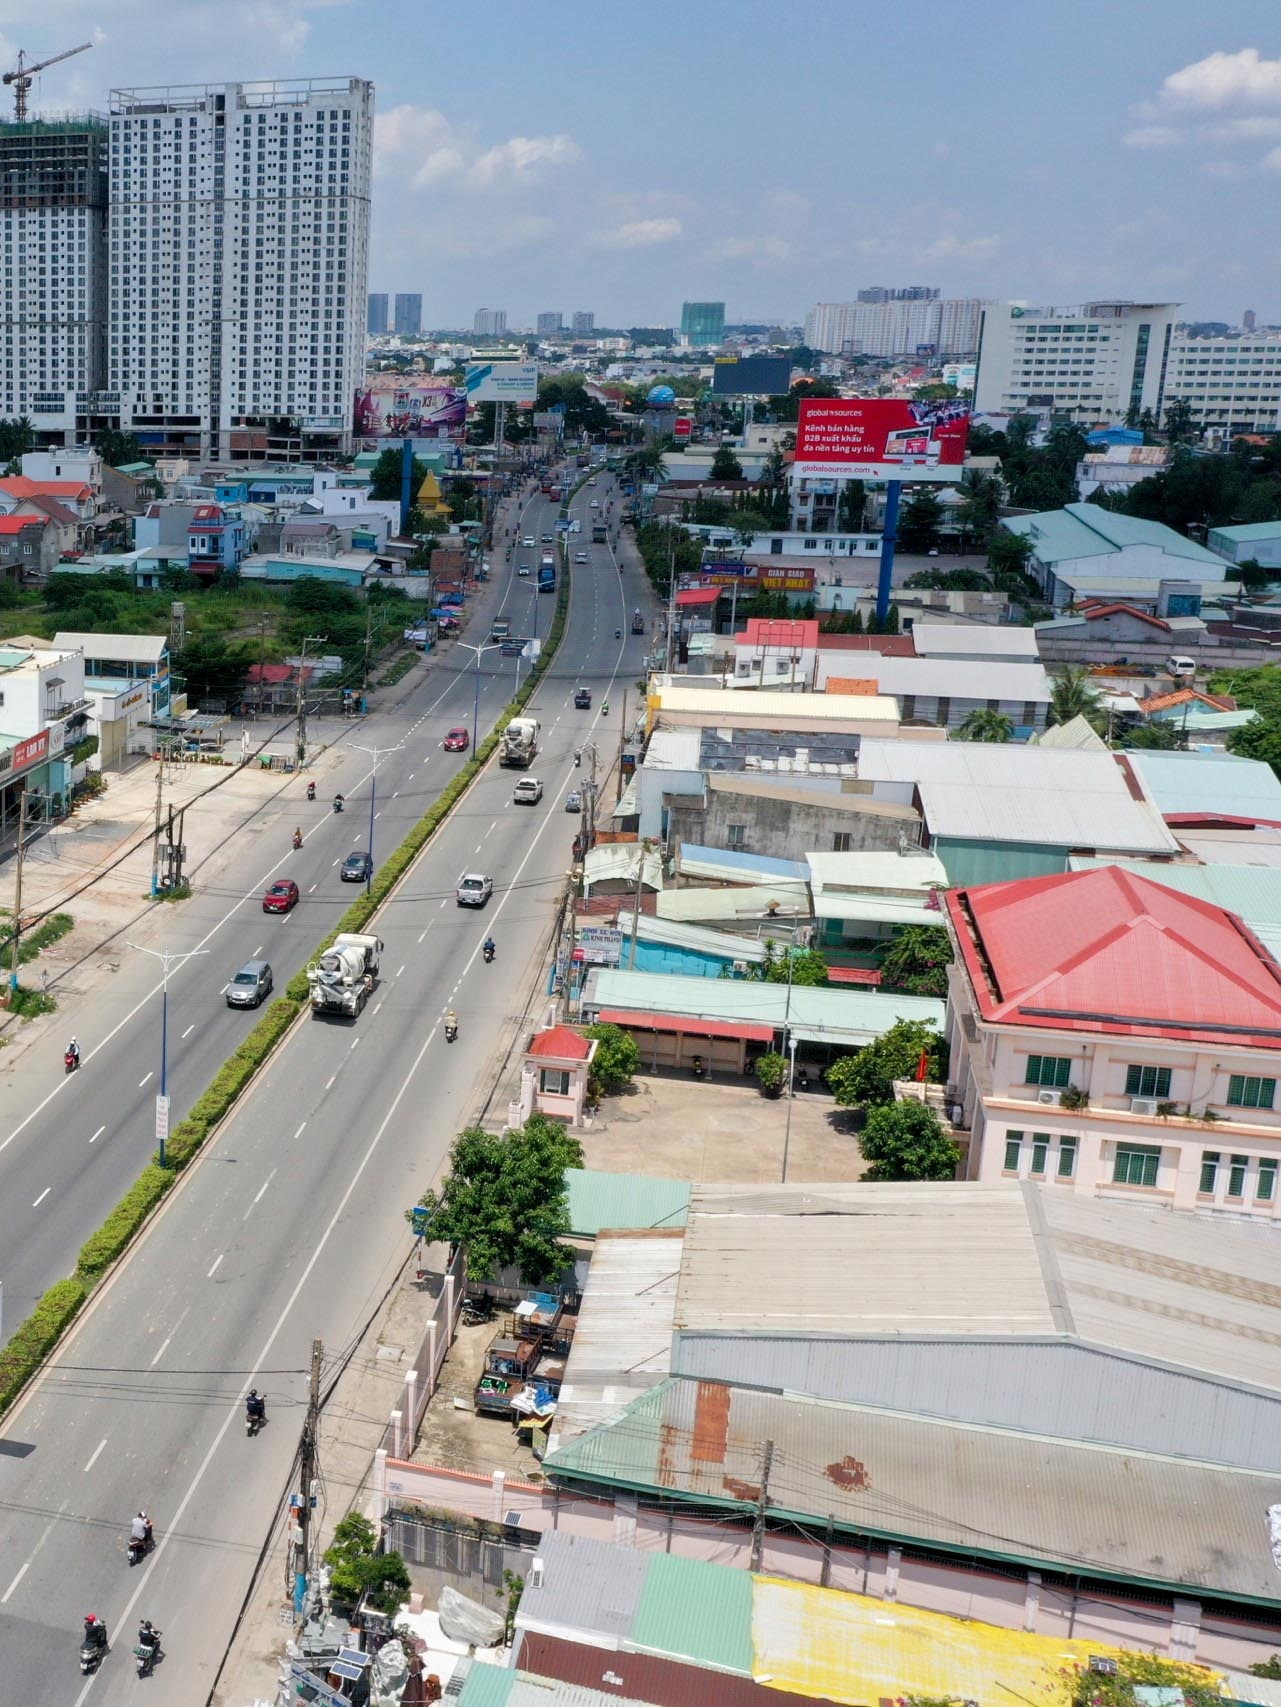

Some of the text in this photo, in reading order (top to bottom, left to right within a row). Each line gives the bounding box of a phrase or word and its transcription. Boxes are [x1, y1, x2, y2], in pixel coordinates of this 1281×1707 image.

[805, 424, 865, 434] Kênh bán hàng
[804, 434, 820, 442] B2B
[851, 446, 862, 454] uy
[802, 464, 871, 474] globalsources.com
